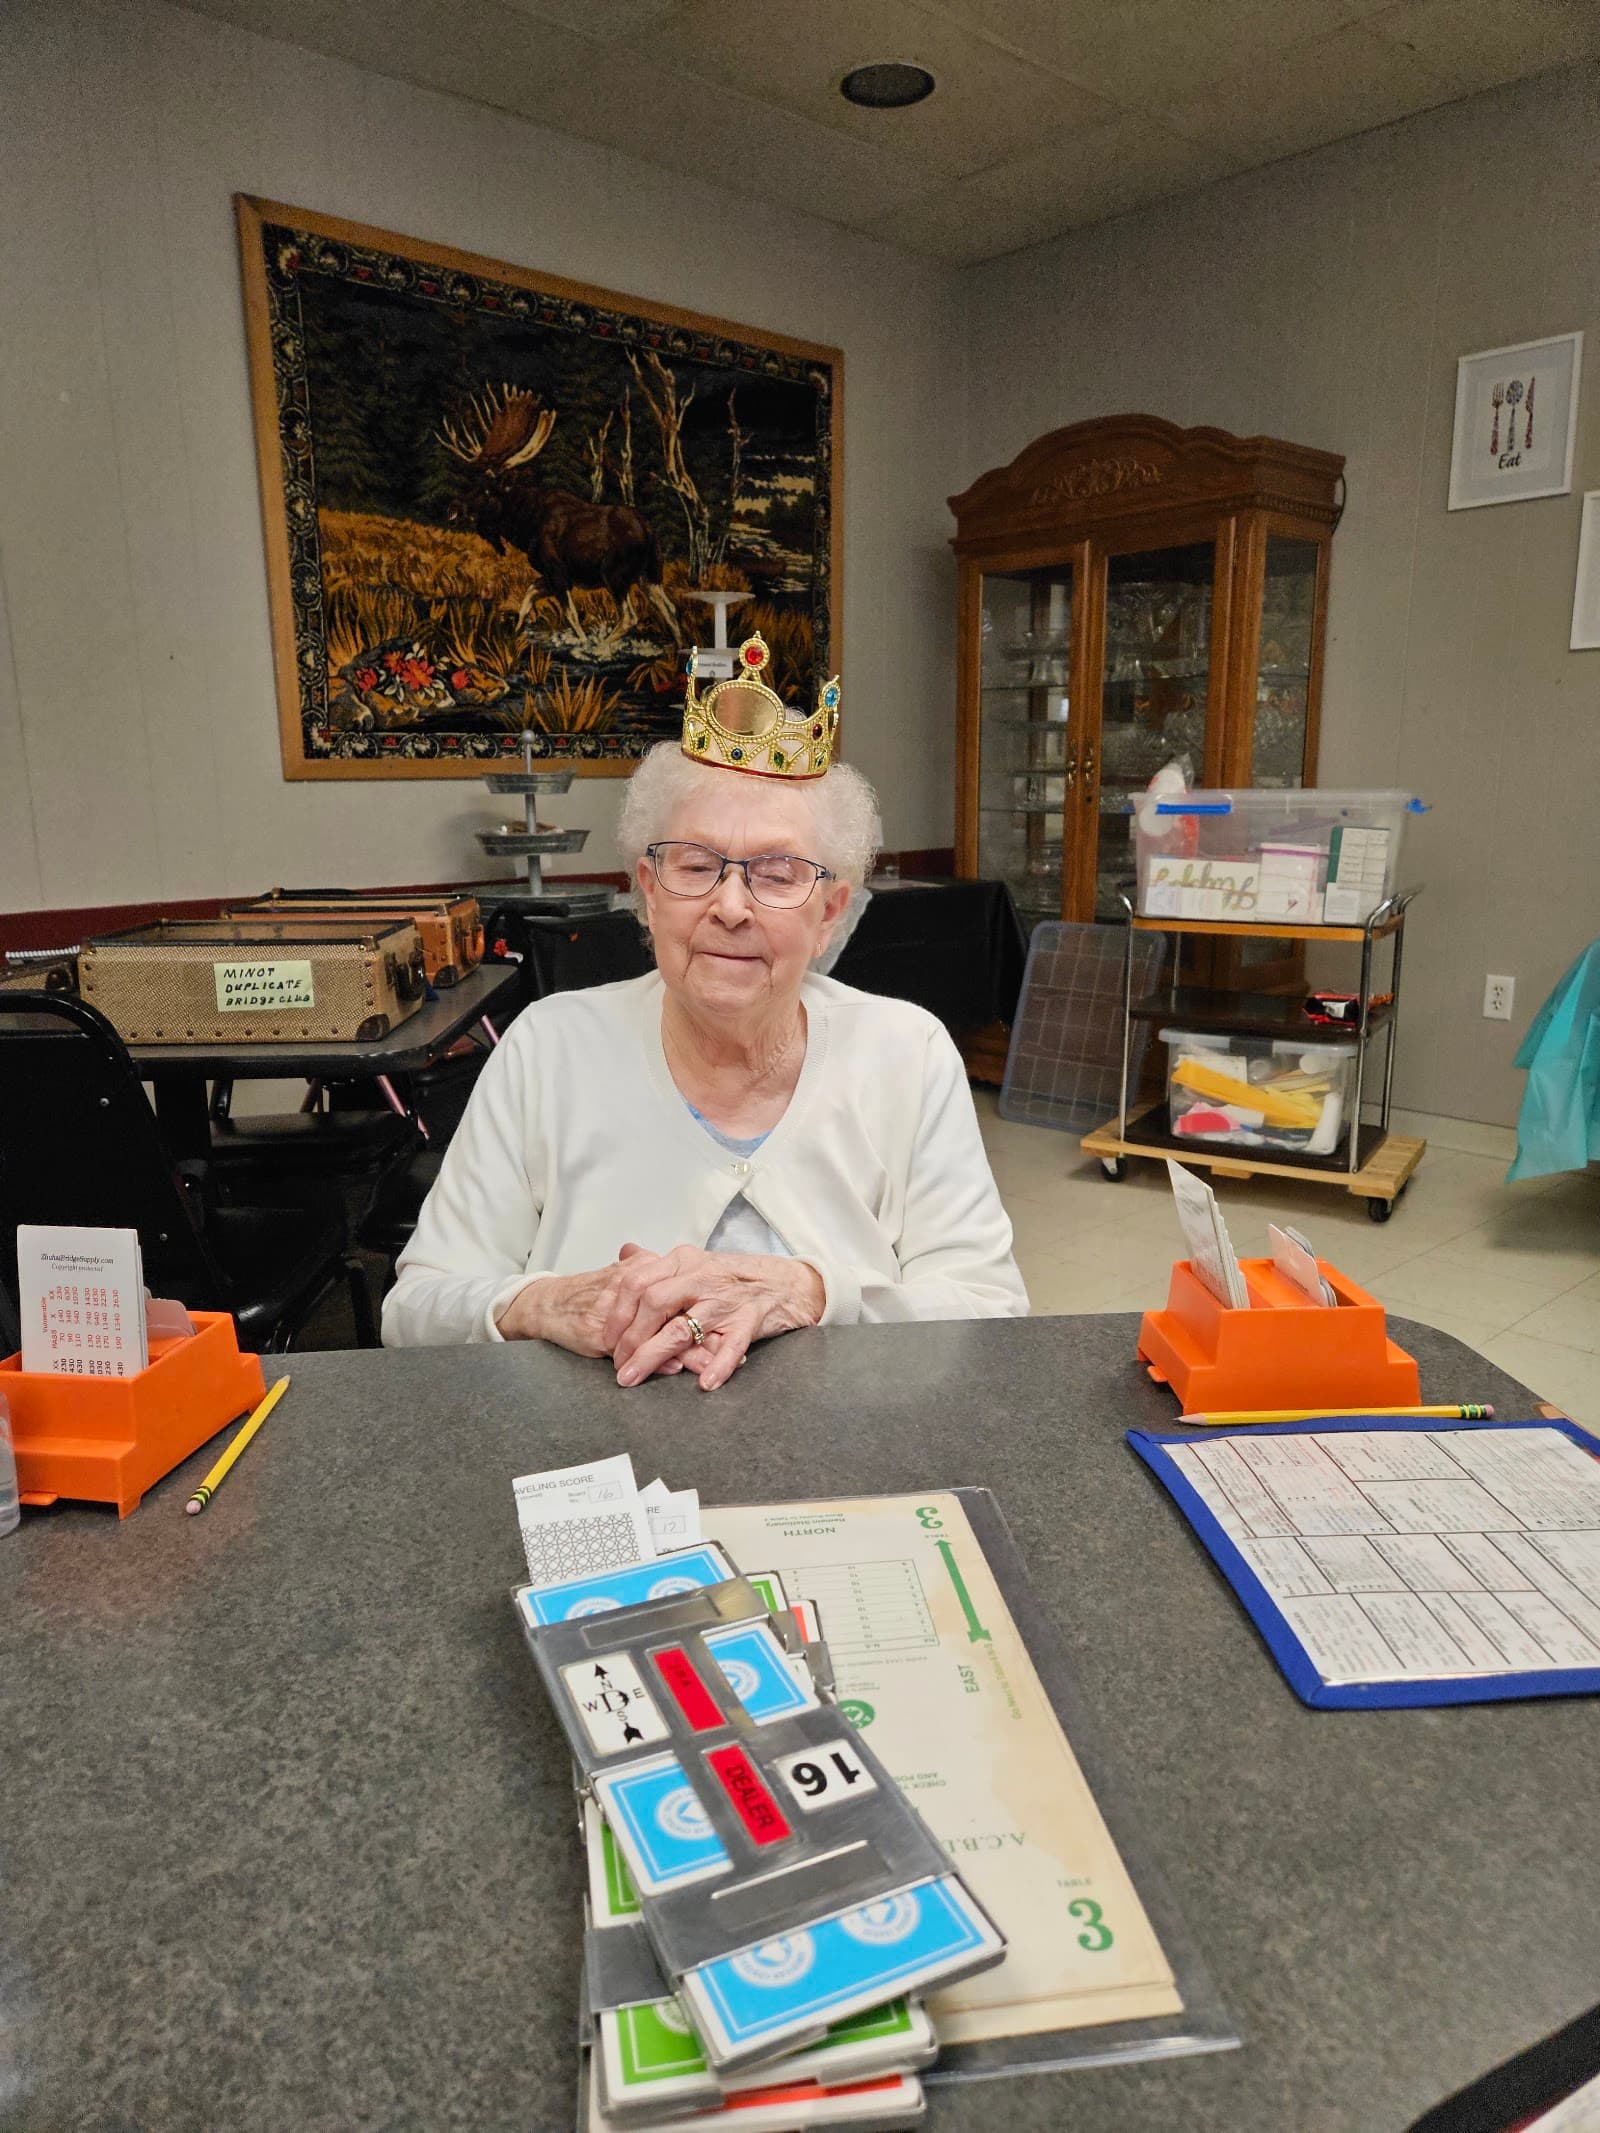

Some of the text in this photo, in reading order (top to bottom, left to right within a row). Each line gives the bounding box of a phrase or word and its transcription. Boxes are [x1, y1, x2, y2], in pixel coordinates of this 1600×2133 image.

[1498, 452, 1521, 469] Eat
[223, 968, 275, 978] MINOT
[225, 980, 302, 993] DUPLICATE
[559, 1474, 594, 1488] SCORE
[915, 1506, 944, 1529] 3
[784, 1527, 836, 1537] NORTH
[957, 1664, 980, 1694] EAST
[582, 1701, 599, 1714] W
[632, 1687, 645, 1699] E
[791, 1752, 860, 1797] 16
[725, 1764, 776, 1830] DEALER
[1067, 1897, 1114, 1952] 3
